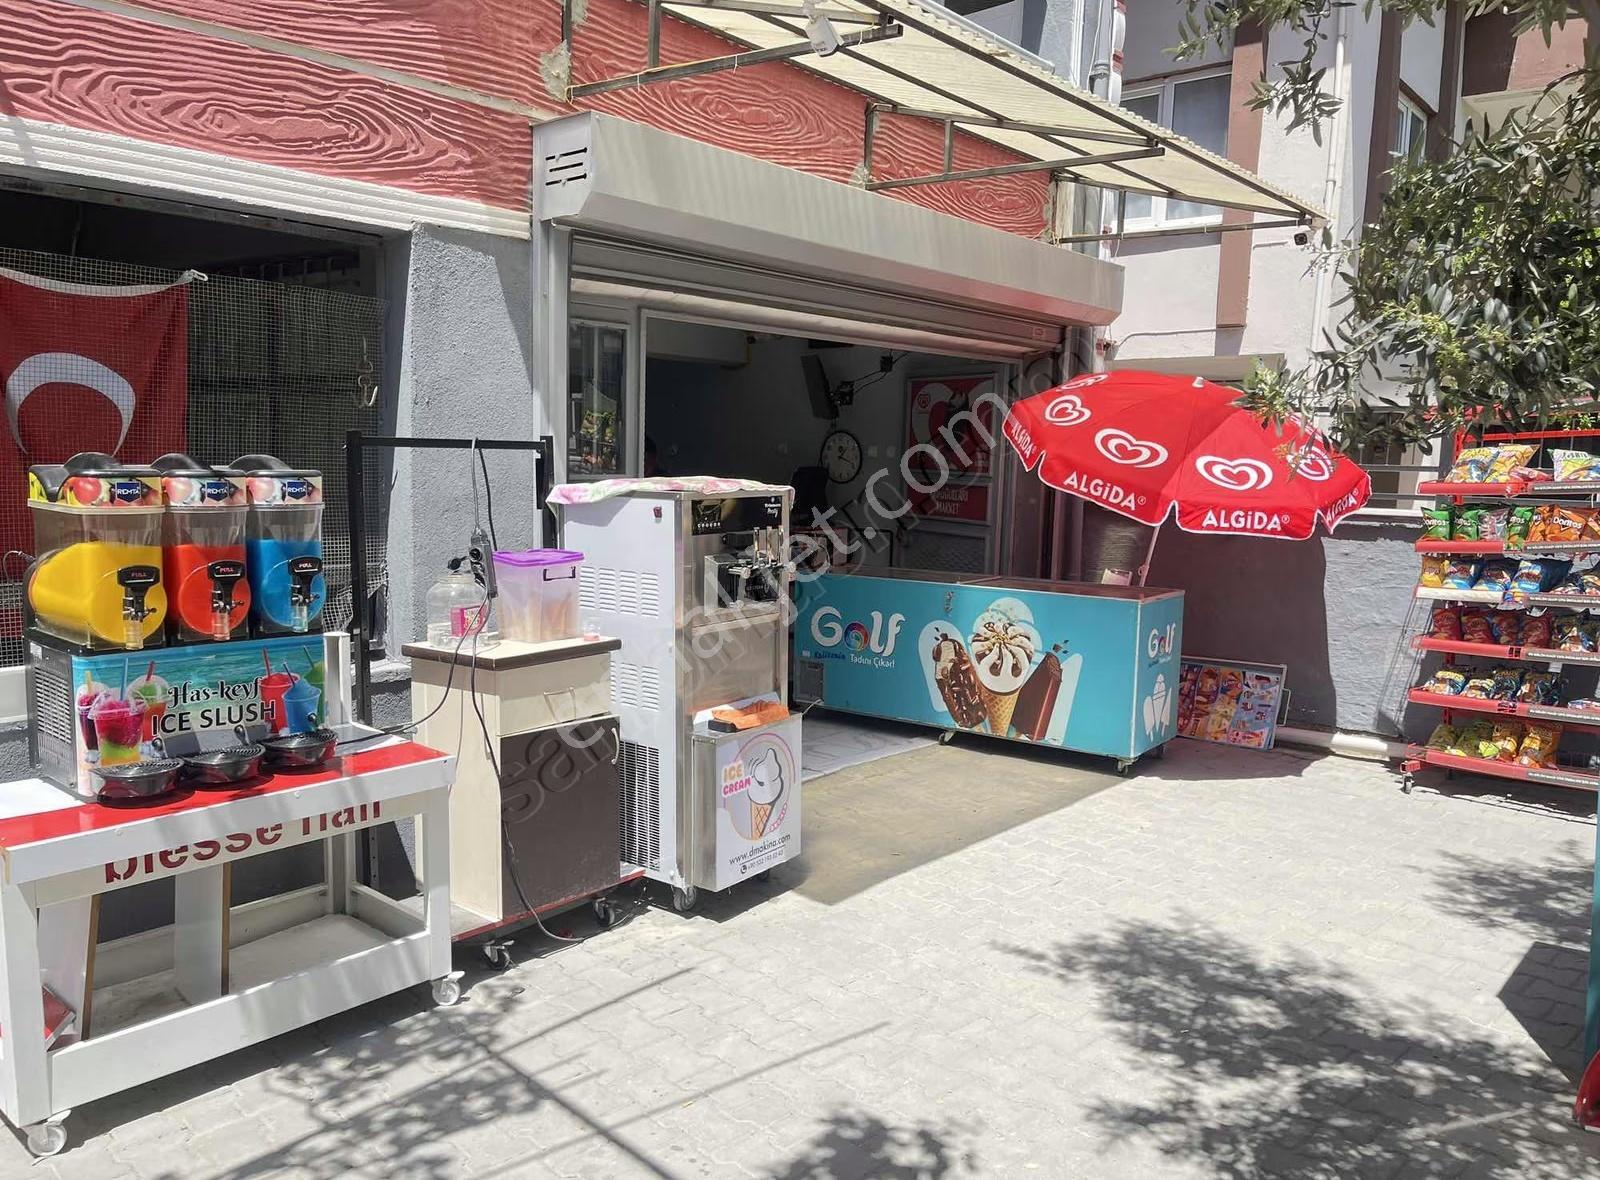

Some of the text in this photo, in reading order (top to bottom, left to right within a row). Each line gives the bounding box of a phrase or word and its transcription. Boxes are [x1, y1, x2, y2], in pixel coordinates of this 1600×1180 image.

[152, 700, 276, 736] ICE SLUSH
[723, 762, 744, 783] ICE
[723, 776, 752, 796] CREAM
